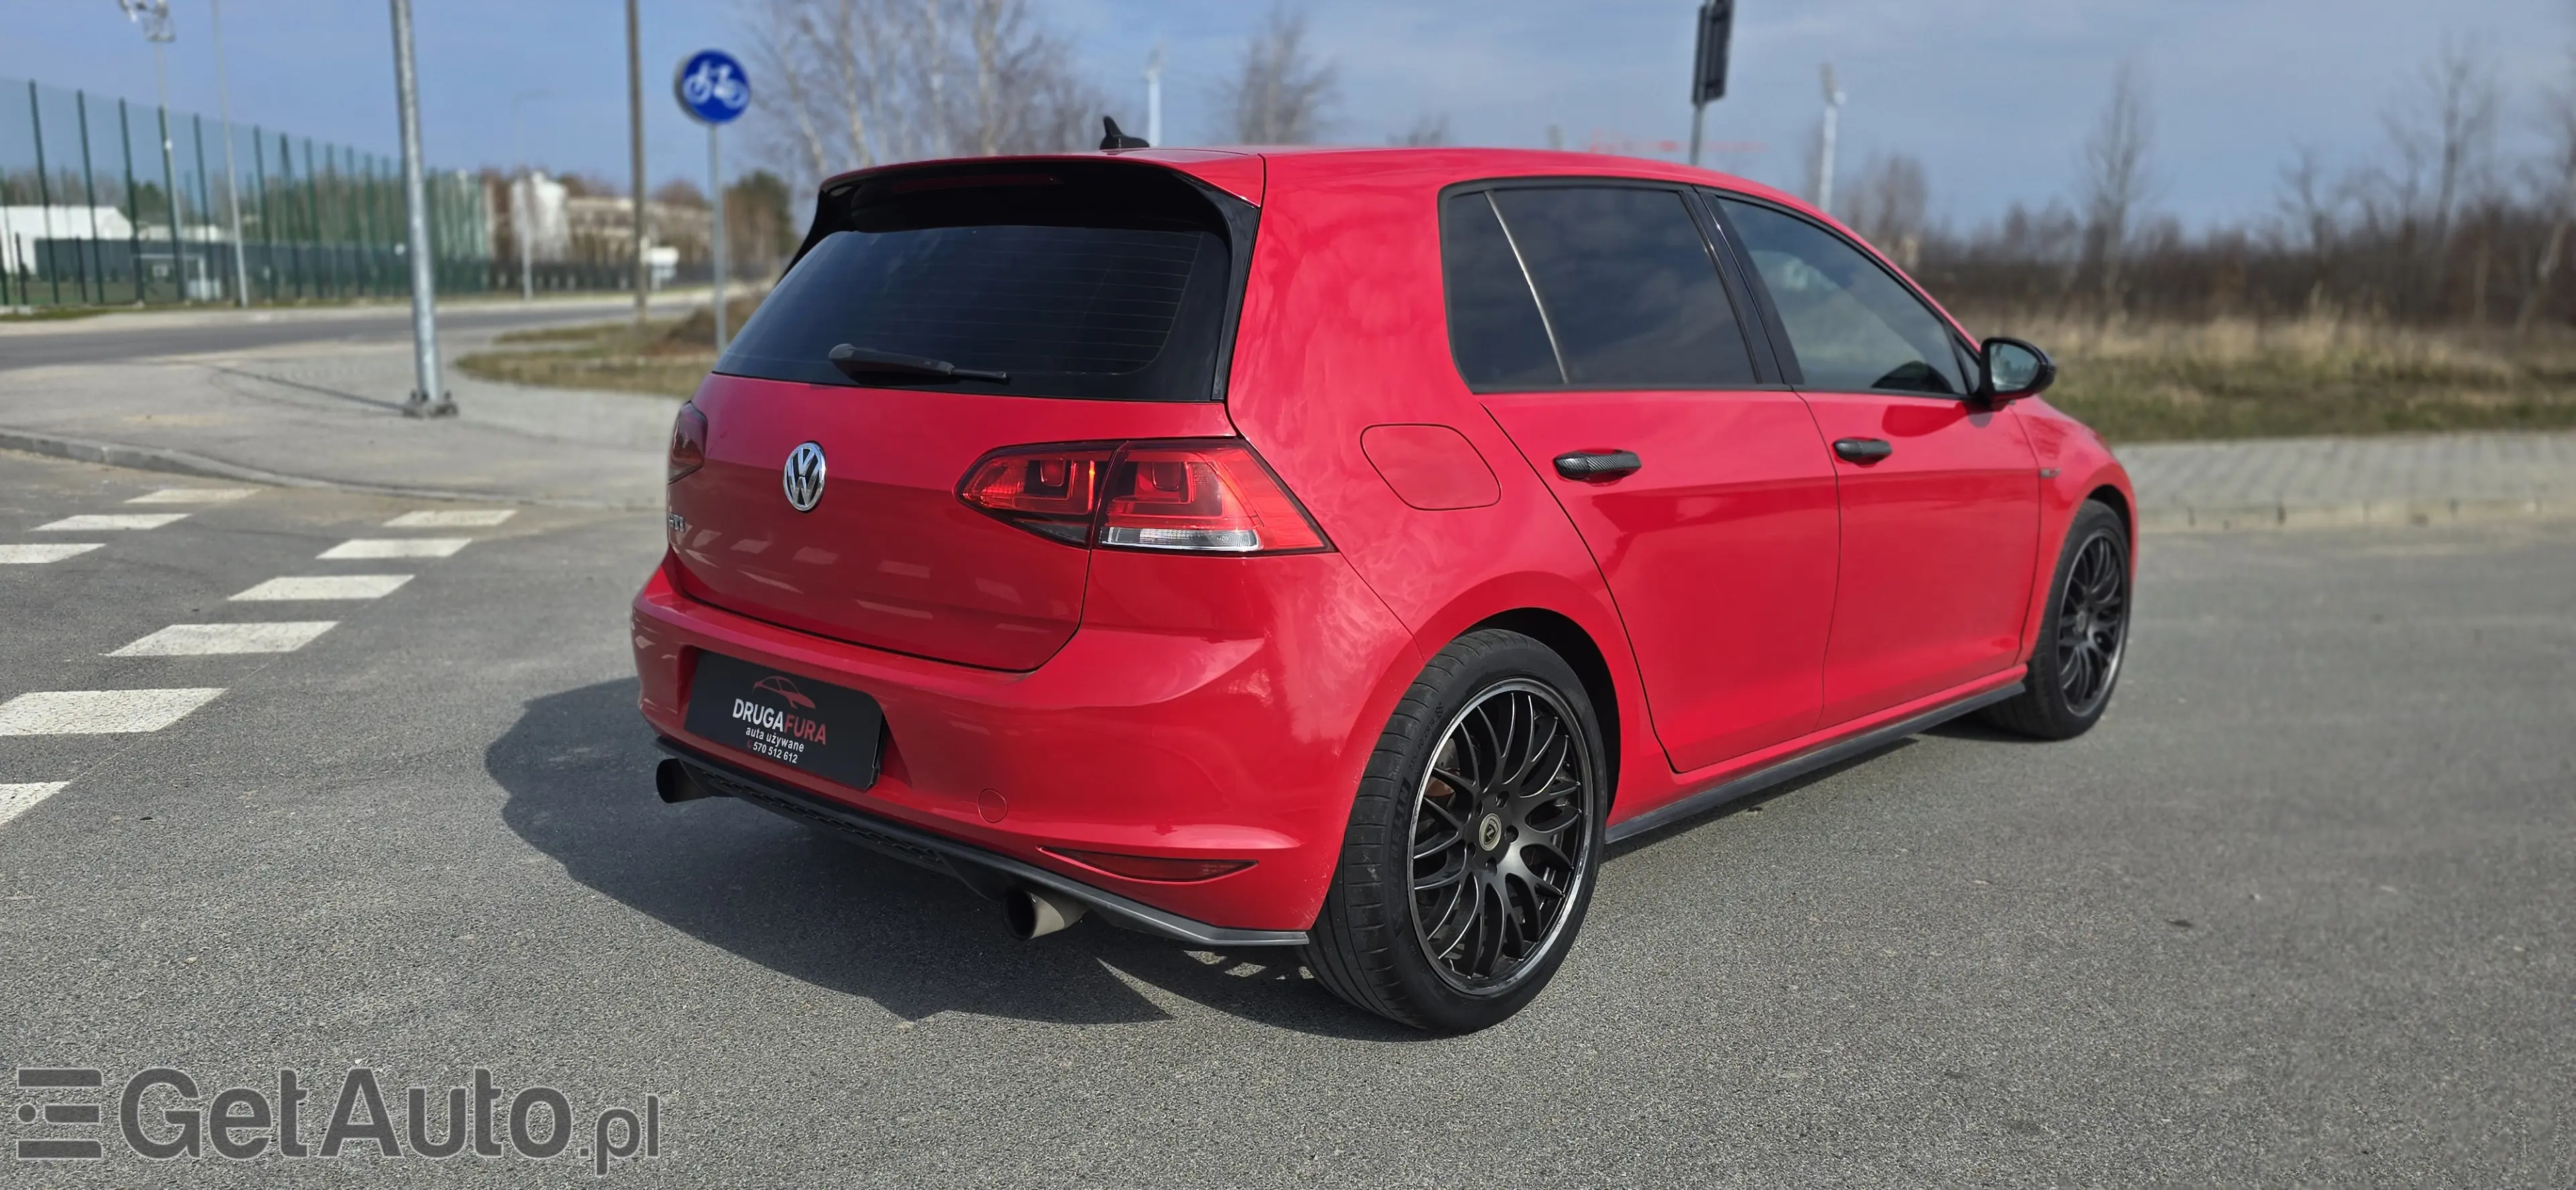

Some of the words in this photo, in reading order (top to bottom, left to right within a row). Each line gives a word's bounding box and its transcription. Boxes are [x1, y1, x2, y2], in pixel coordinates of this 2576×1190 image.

[732, 698, 826, 745] DRUGAFURA
[746, 726, 764, 740] auta
[765, 732, 804, 752] używane
[753, 741, 767, 753] 570
[767, 746, 782, 759] 512
[783, 751, 798, 763] 612
[1389, 785, 1409, 899] ICHELIN
